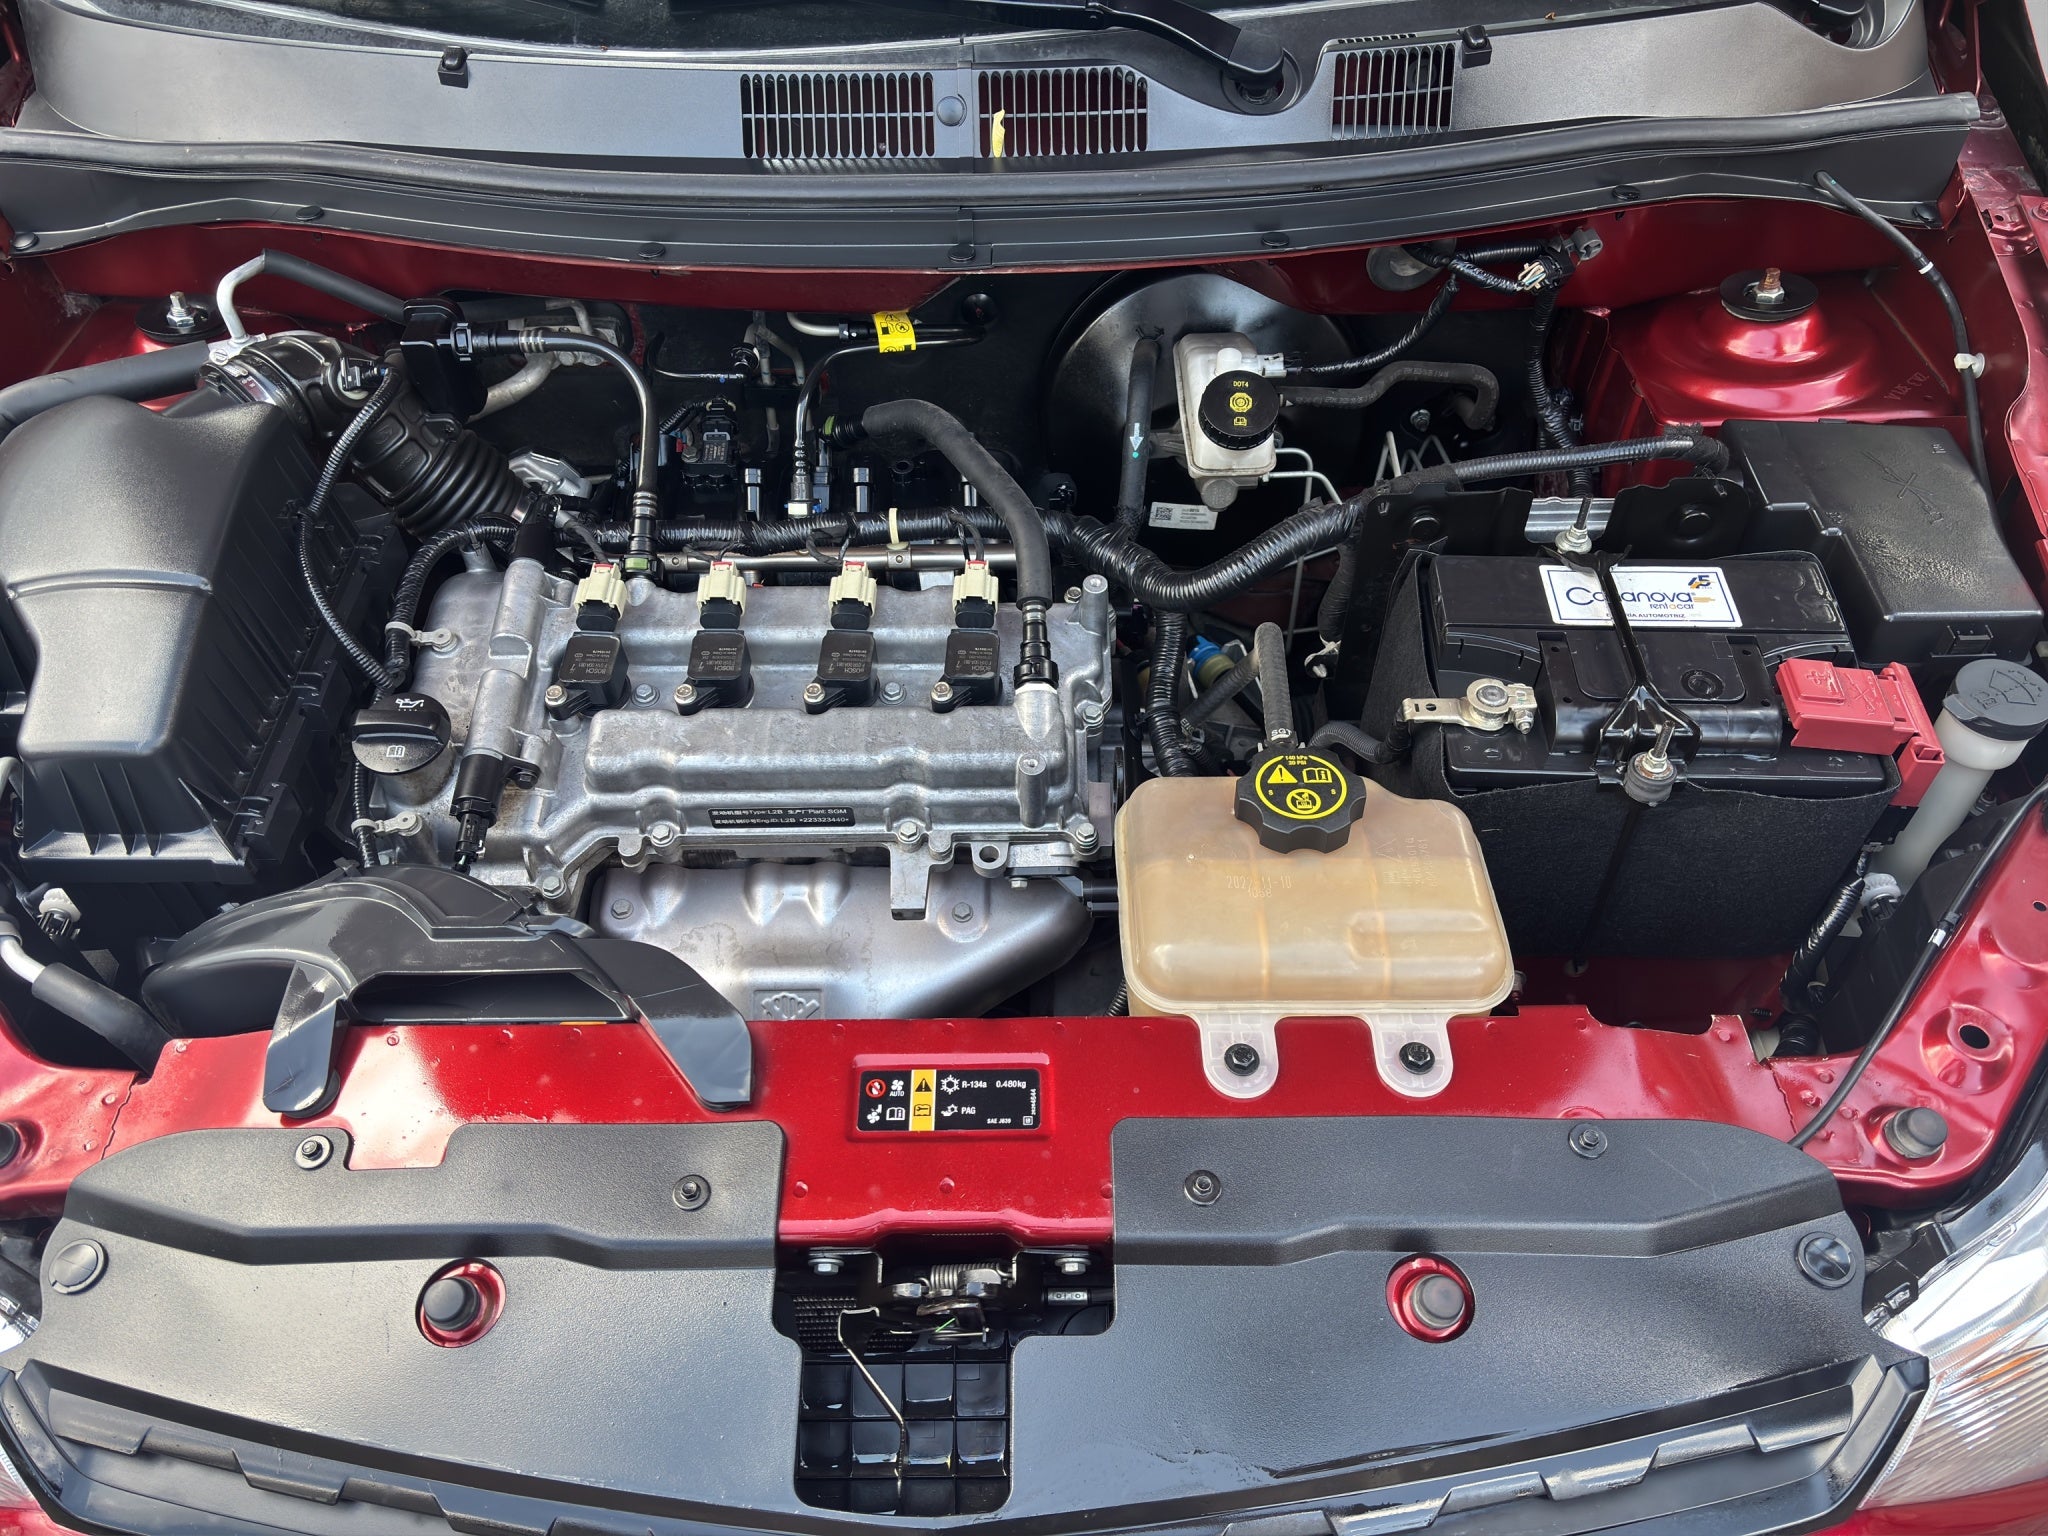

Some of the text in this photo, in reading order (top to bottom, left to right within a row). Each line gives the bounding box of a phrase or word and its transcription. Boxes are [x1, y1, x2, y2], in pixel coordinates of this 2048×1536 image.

[1233, 380, 1249, 388] DOT4
[1565, 586, 1693, 606] Caanova
[961, 1080, 988, 1089] R-134a
[961, 1106, 976, 1115] PAG
